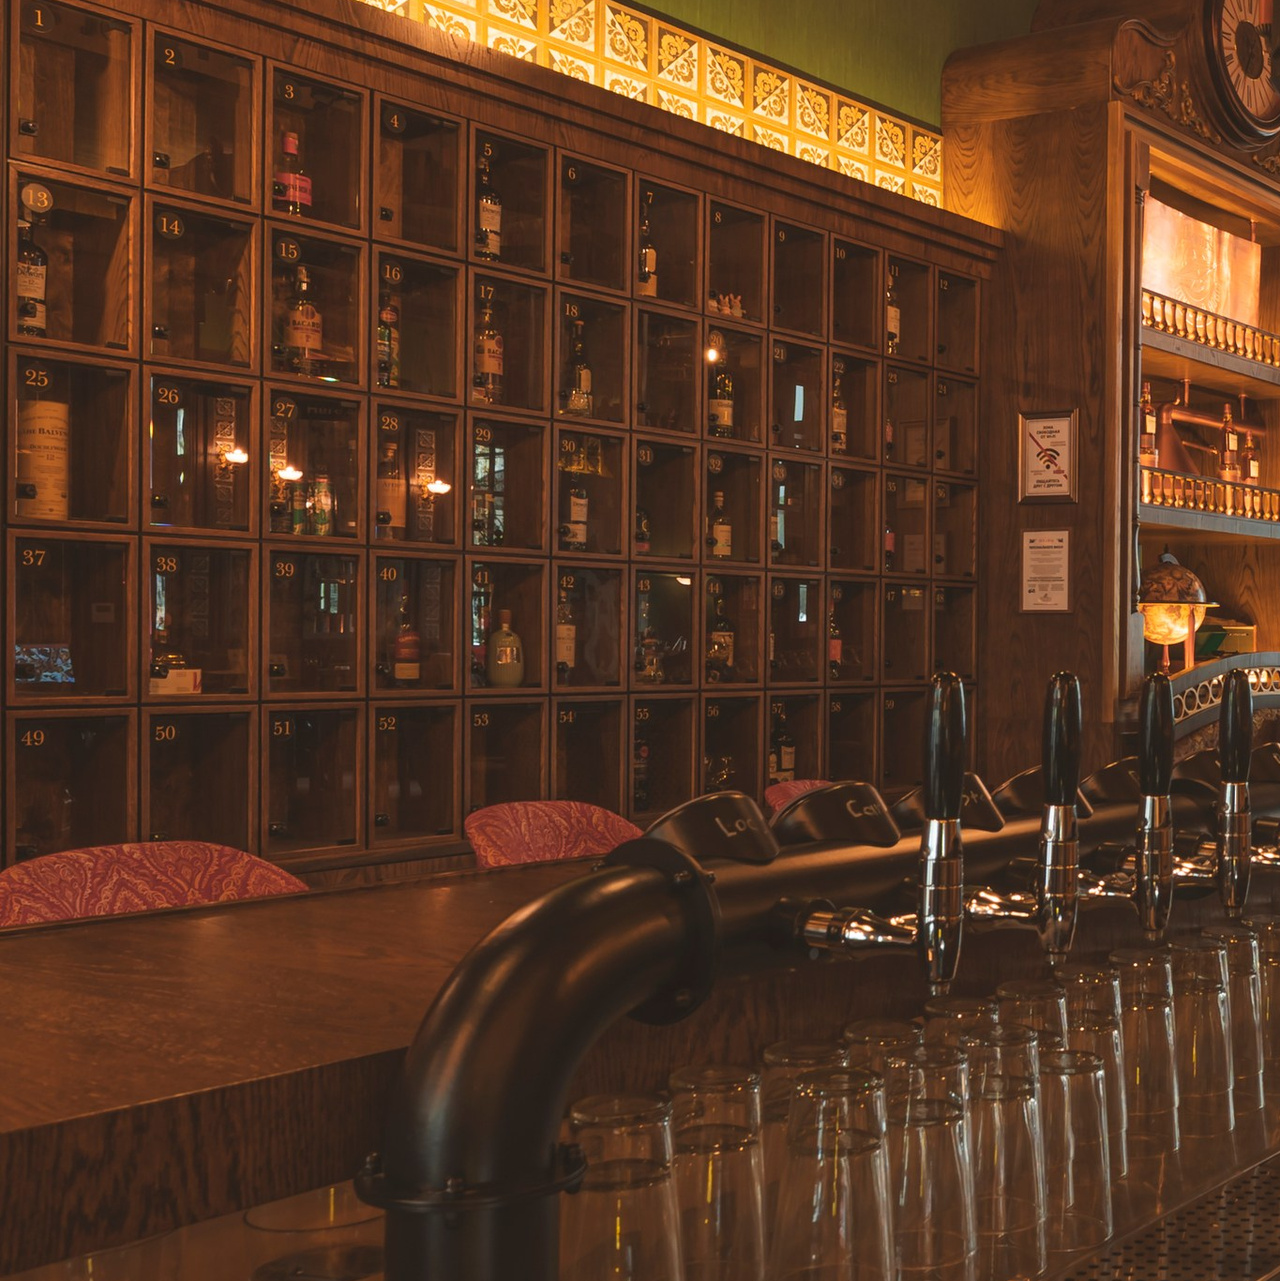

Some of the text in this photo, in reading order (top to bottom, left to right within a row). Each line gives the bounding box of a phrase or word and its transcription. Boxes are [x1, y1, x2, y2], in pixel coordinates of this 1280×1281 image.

[34, 9, 44, 27] 1
[164, 48, 175, 65] 2
[285, 85, 294, 99] 3
[391, 114, 399, 128] 4
[484, 143, 492, 156] 5
[568, 168, 576, 179] 6
[28, 189, 48, 207] 13
[646, 192, 653, 204] 7
[715, 212, 722, 223] 8
[161, 217, 180, 235] 14
[779, 231, 786, 242] 9
[280, 242, 298, 259] 15
[836, 247, 846, 259] 10
[384, 265, 401, 281] 16
[890, 265, 899, 277] 11
[939, 279, 948, 290] 12
[480, 285, 494, 299] 17
[565, 304, 578, 317] 18
[292, 319, 321, 329] BACARD
[774, 348, 785, 360] 21
[25, 369, 49, 387] 25
[157, 388, 179, 404] 26
[276, 402, 295, 418] 27
[381, 416, 398, 431] 28
[475, 427, 491, 441] 29
[561, 440, 576, 452] 30
[639, 449, 651, 462] 31
[709, 458, 721, 470] 32
[22, 550, 46, 566] 37
[156, 557, 177, 572] 38
[275, 562, 295, 577] 39
[380, 567, 397, 581] 40
[475, 572, 489, 584] 41
[560, 576, 575, 589] 42
[637, 579, 650, 592] 43
[708, 583, 720, 594] 44
[773, 585, 784, 596] 45
[886, 591, 896, 601] 47
[707, 706, 720, 717] 56
[772, 703, 783, 714] 57
[831, 702, 841, 713] 58
[885, 700, 895, 710] 59
[473, 714, 489, 727] 53
[560, 711, 573, 723] 54
[636, 709, 650, 720] 55
[273, 721, 291, 735] 51
[379, 717, 396, 731] 52
[21, 730, 45, 746] 49
[155, 726, 176, 741] 50
